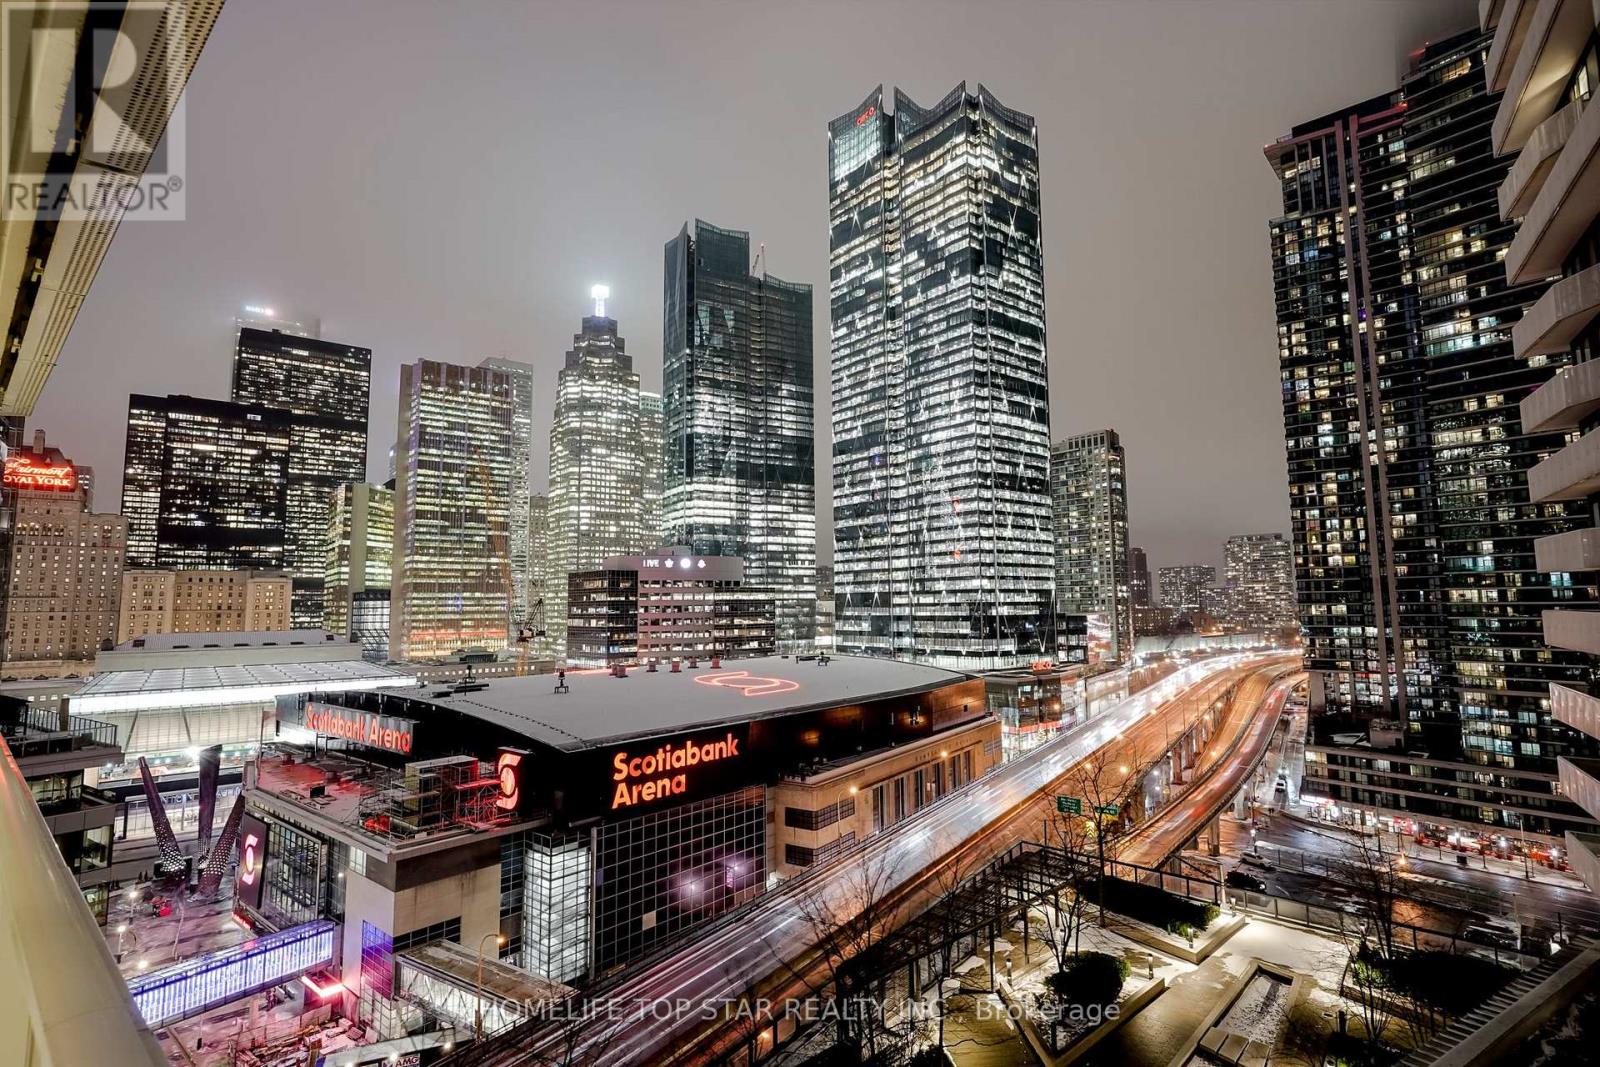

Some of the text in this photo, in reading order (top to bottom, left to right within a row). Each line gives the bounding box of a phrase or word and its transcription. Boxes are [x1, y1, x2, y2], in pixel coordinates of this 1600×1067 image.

[3, 475, 71, 487] OYAL YORK
[306, 704, 410, 752] Scotiabank Arena
[613, 732, 739, 781] Scotiabank
[611, 773, 687, 810] Arena
